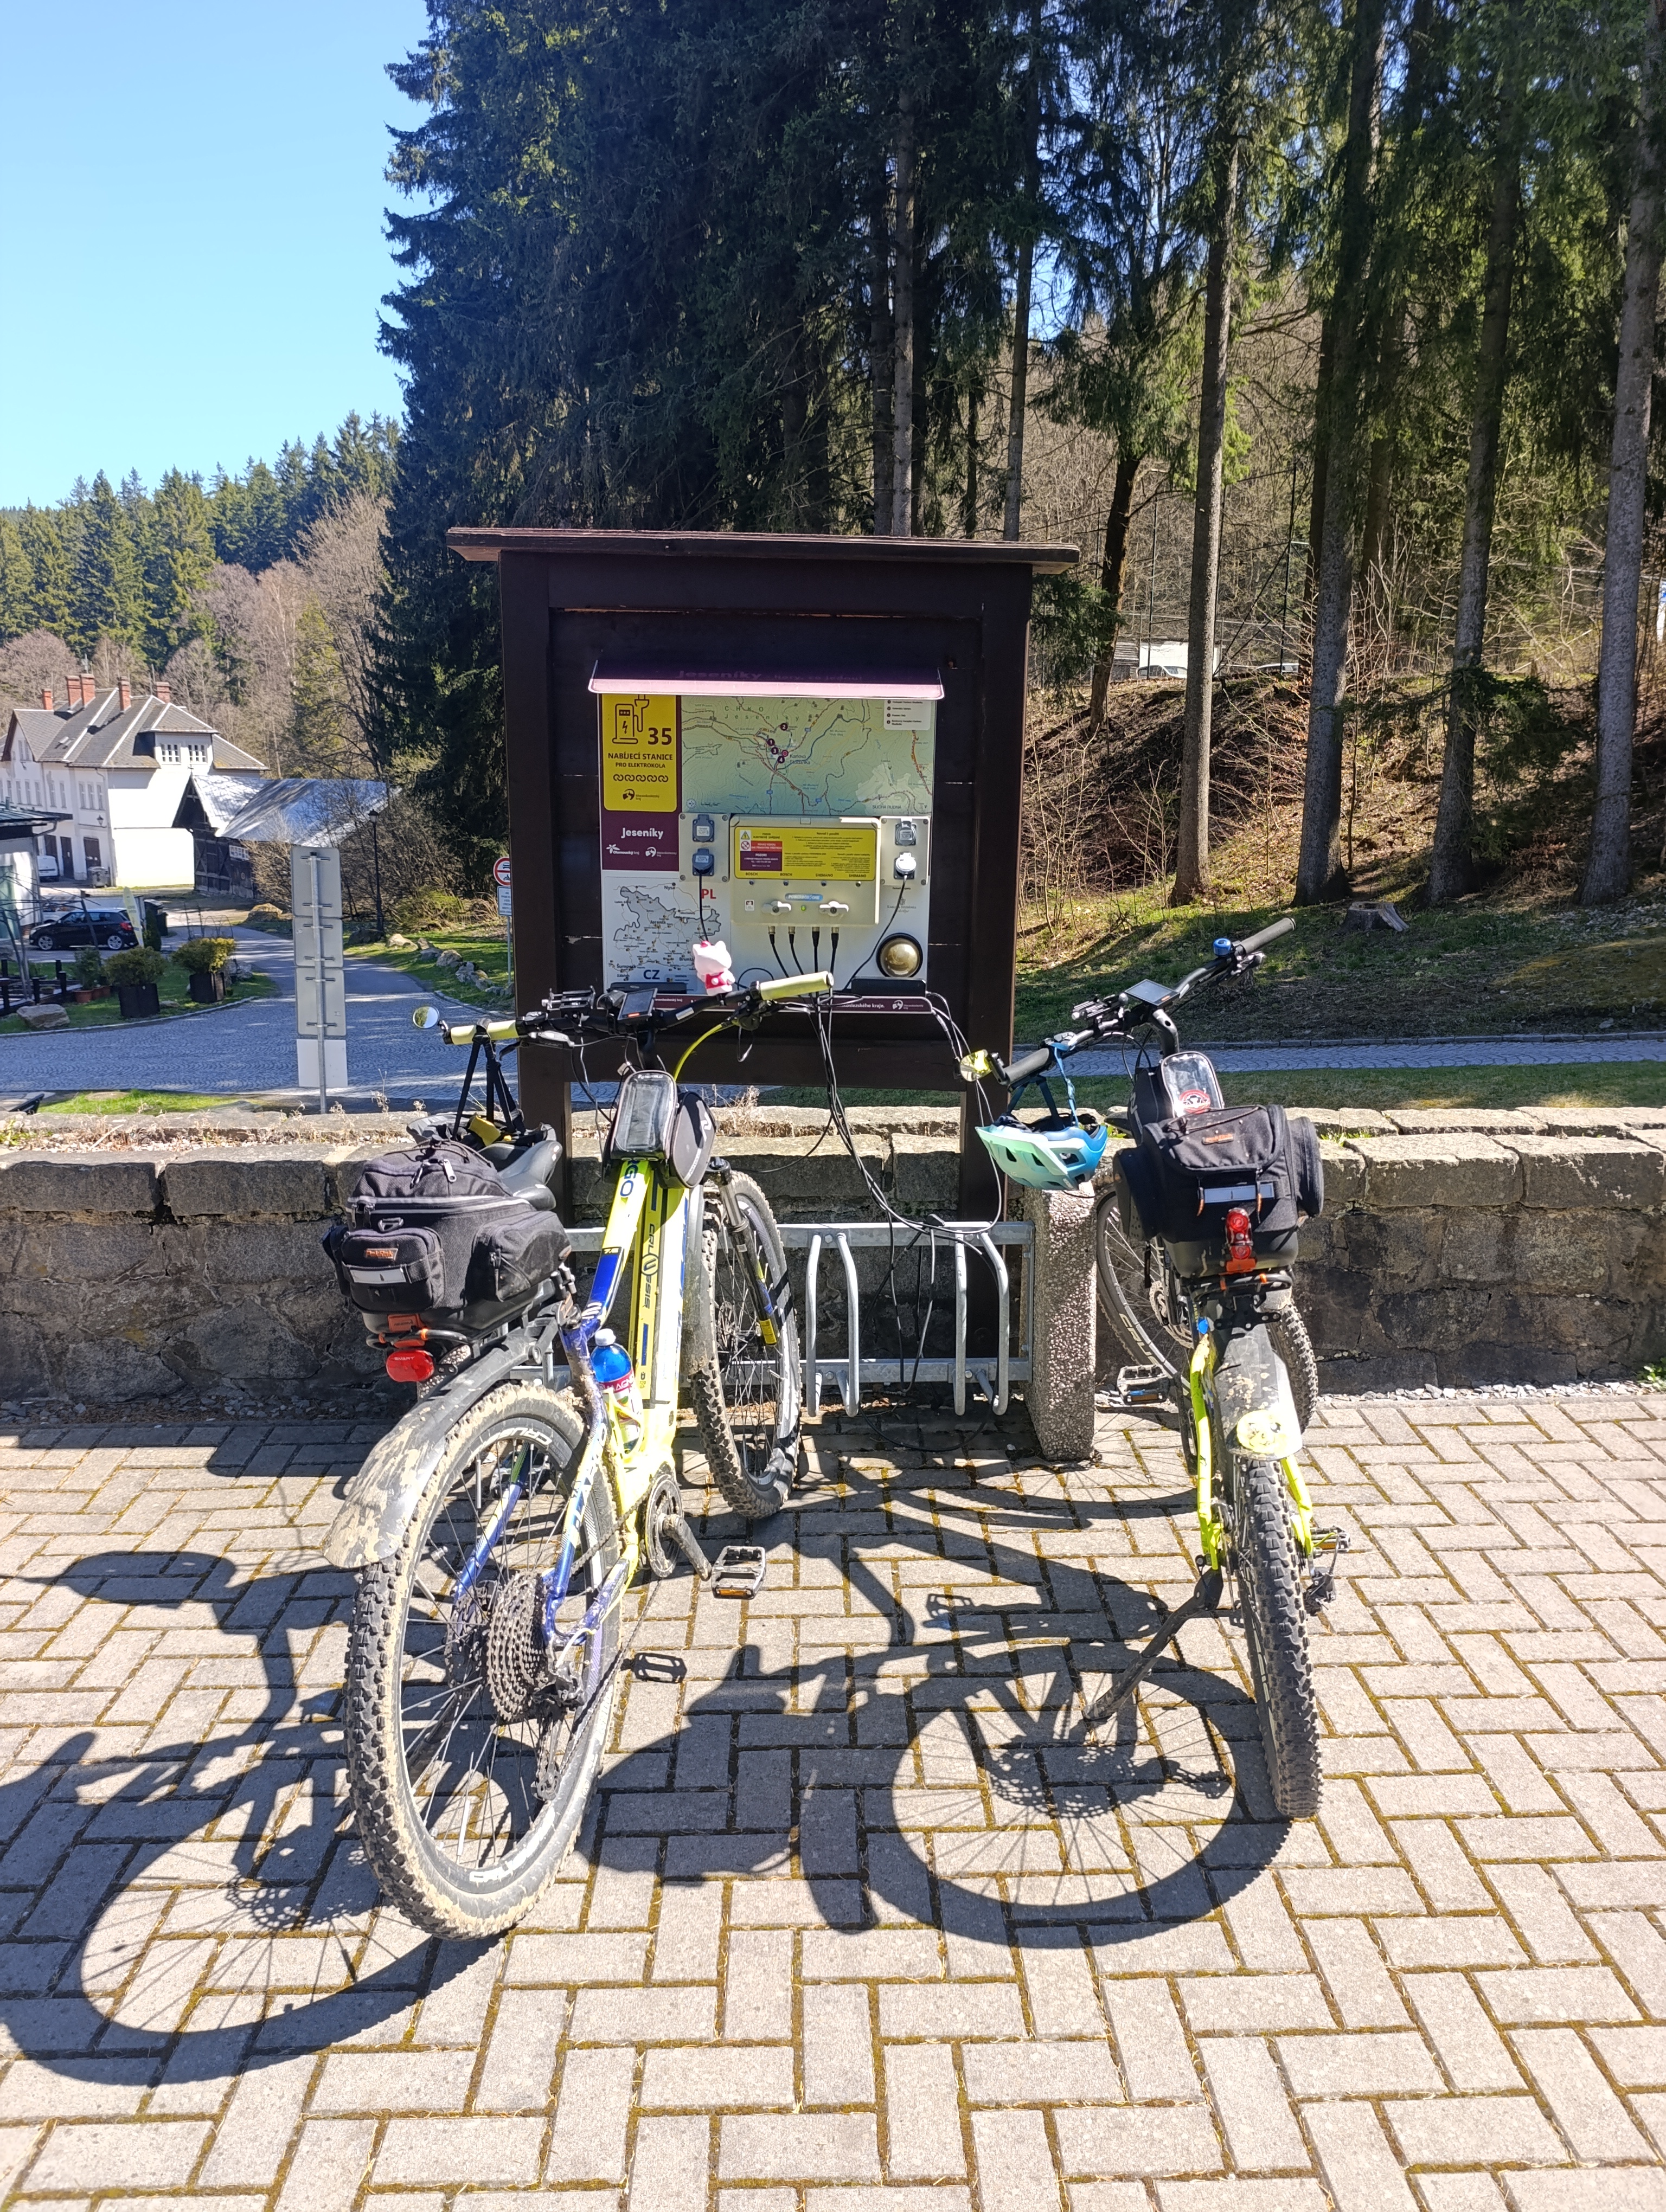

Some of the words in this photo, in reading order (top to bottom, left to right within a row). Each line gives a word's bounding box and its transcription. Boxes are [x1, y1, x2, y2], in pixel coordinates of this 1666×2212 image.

[648, 727, 672, 745] 35
[608, 751, 640, 760] NABÍJECÍ
[621, 827, 663, 839] Jeseníky
[701, 889, 716, 899] PL
[643, 969, 660, 980] CZ
[607, 1375, 635, 1392] MAGN
